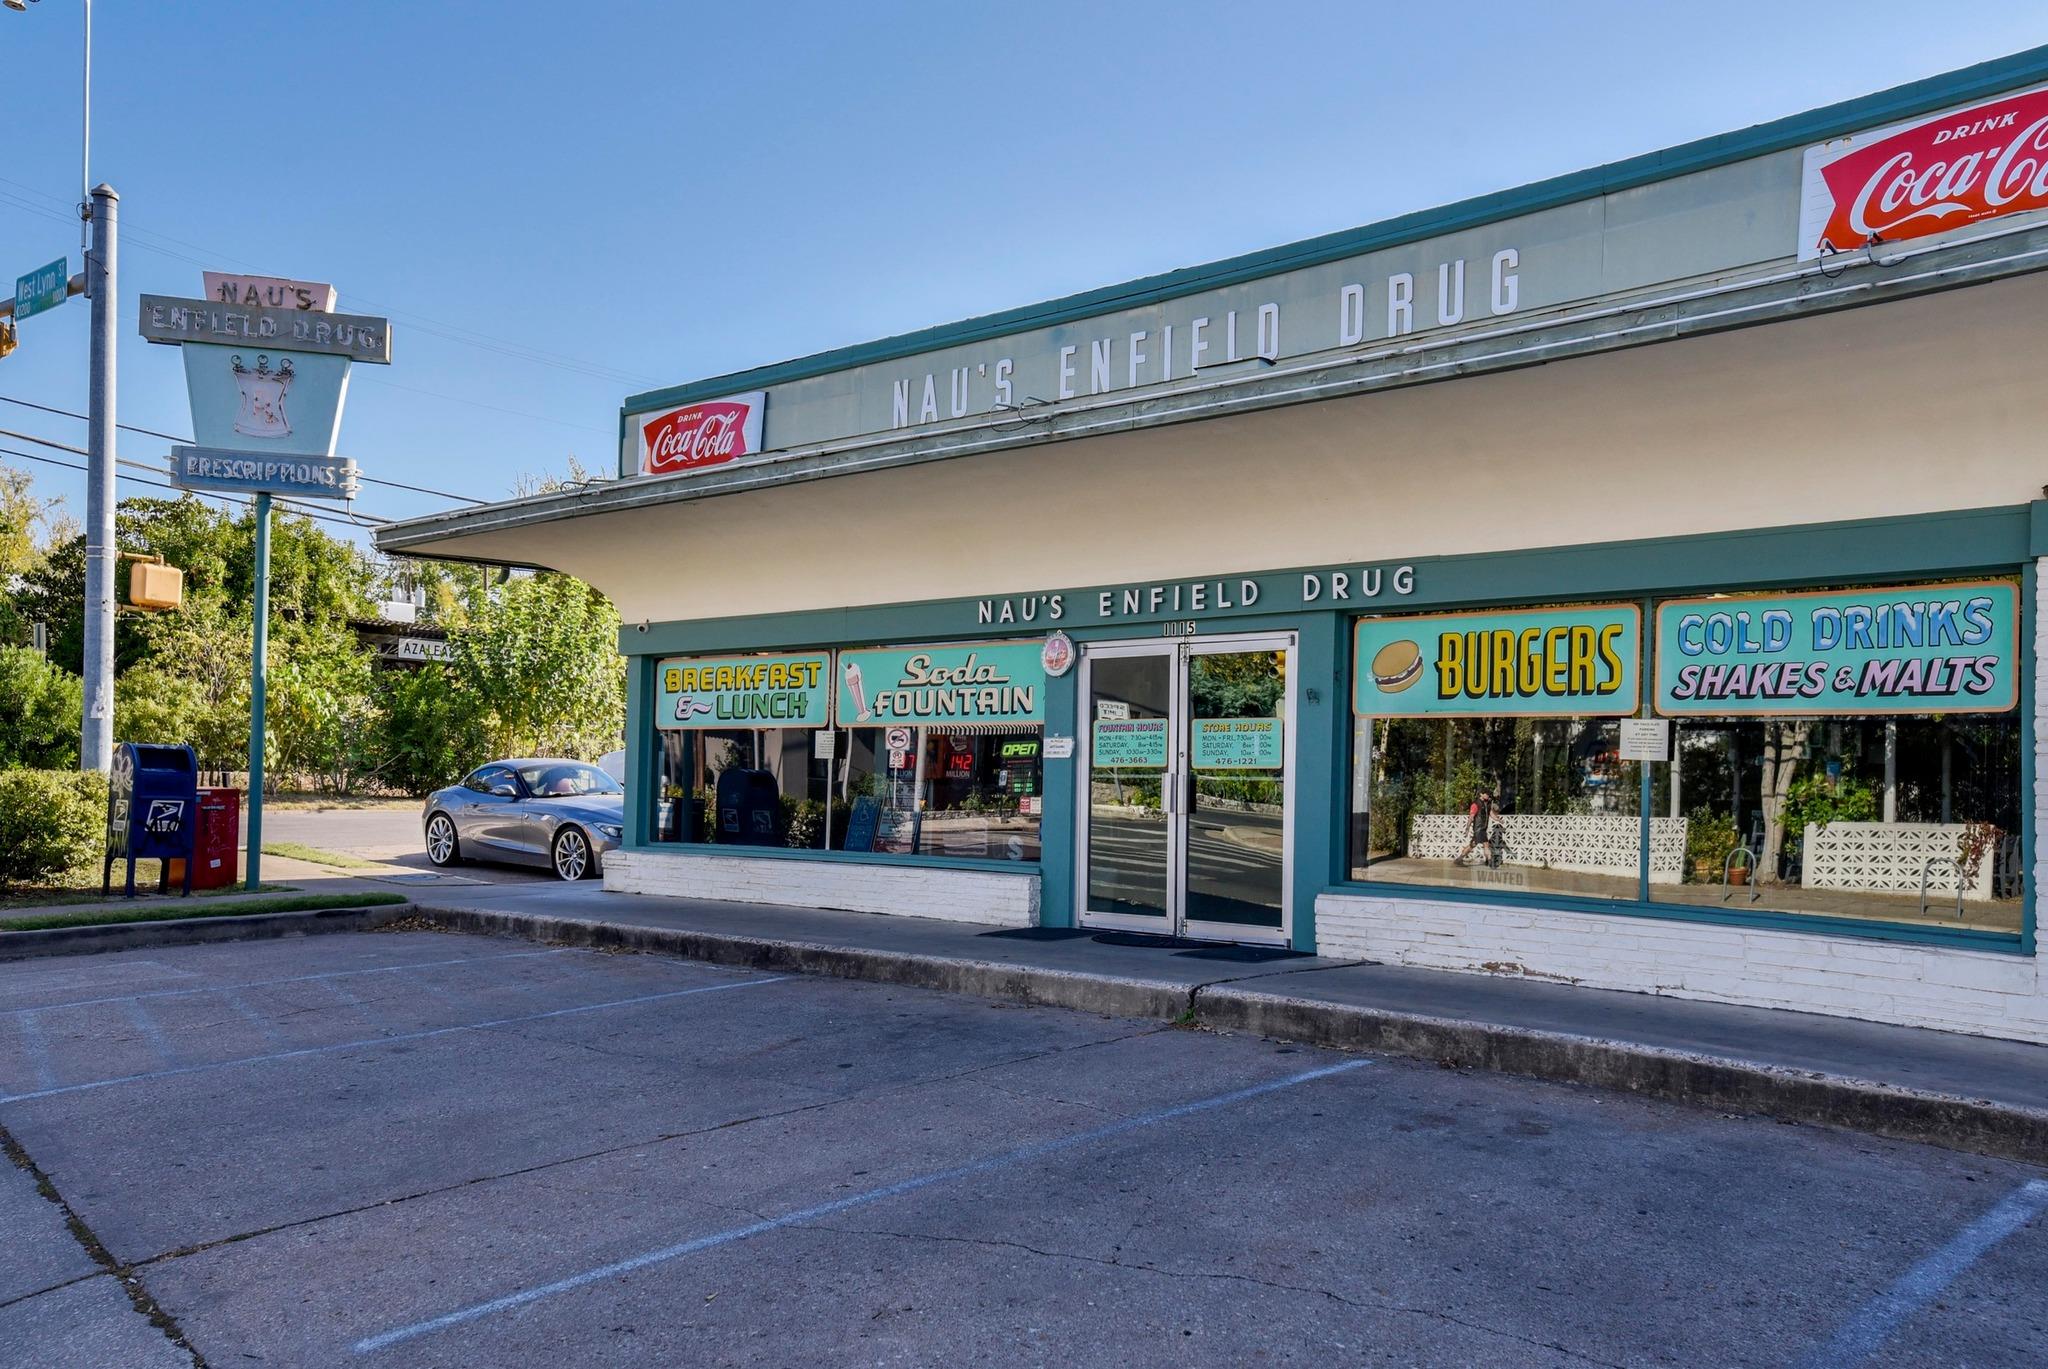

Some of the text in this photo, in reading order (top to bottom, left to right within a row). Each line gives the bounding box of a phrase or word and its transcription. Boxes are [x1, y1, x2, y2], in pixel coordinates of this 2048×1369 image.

[1932, 111, 2019, 145] DRINK
[18, 278, 36, 302] West
[37, 270, 56, 297] Lynn
[219, 281, 315, 311] NAU'S
[151, 304, 381, 349] ENFIELD DRUG
[893, 249, 1519, 429] NAU'S ENFIELD DRUG
[677, 411, 704, 424] DRINK
[651, 410, 740, 468] Coca-Cola
[187, 456, 337, 487] PRESCRIPTIONS
[978, 566, 1414, 624] NAU'S ENFIELD DRUG
[1163, 621, 1195, 637] 1115
[1678, 597, 1994, 657] COLD DRINKS
[664, 661, 823, 694] BREAKFAST
[898, 653, 1011, 688] Soda
[1434, 624, 1624, 700] BURGERS
[1671, 655, 2000, 700] SHAKES & MALTS
[716, 691, 809, 720] LUNCH
[872, 685, 1034, 718] FOUNTAIN
[1098, 722, 1164, 733] FOUNTAIN HOURS
[1202, 722, 1272, 733] STORE HOURS
[950, 754, 972, 770] 142
[1002, 743, 1037, 756] OPEN
[1475, 869, 1523, 885] WANTED
